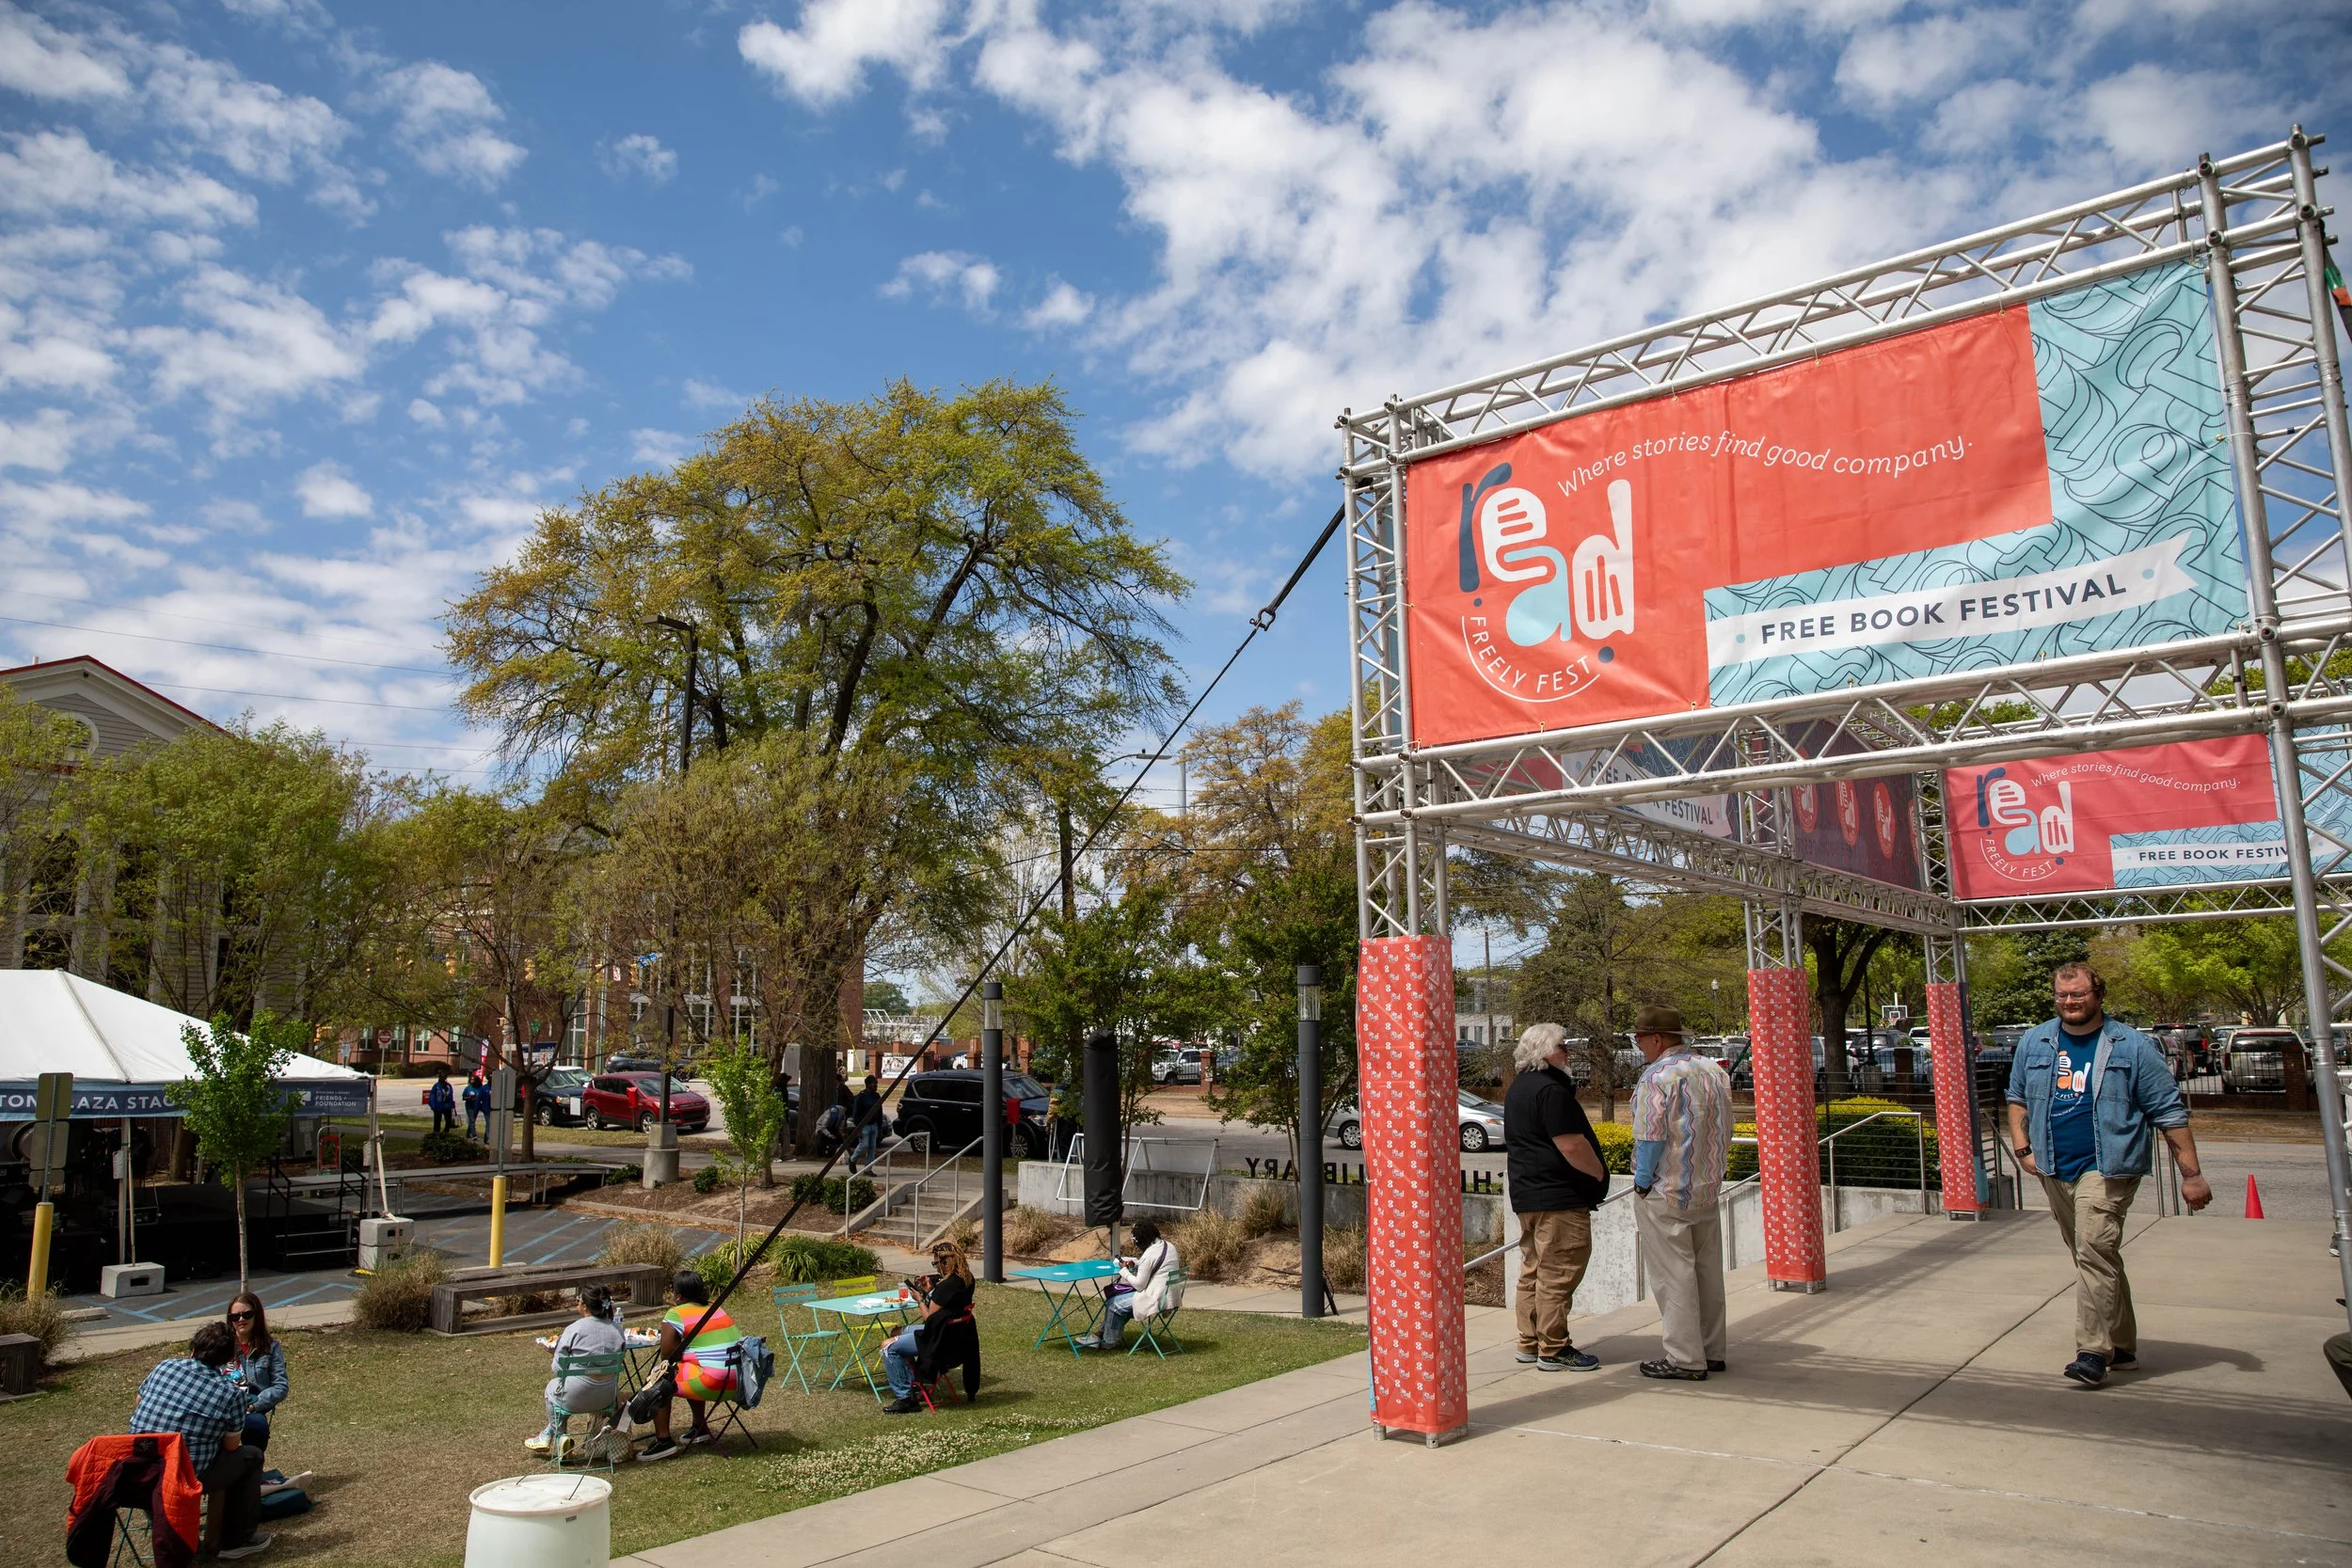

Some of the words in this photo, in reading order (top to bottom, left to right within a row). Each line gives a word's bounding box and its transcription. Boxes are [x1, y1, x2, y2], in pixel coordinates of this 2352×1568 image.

[1557, 451, 1627, 498] Where
[1632, 432, 1711, 460] stories
[1710, 430, 1766, 457] find
[1764, 445, 1831, 467] good
[1834, 436, 1973, 478] company.
[1458, 462, 1634, 646] read
[1761, 615, 1836, 644] FREE
[1851, 601, 1944, 632] BOOK
[1961, 573, 2126, 621] FESTIVAL
[1470, 616, 1527, 689] FREELY
[1536, 656, 1595, 693] FEST
[2030, 767, 2069, 787] Where
[2071, 762, 2112, 773] stories
[2112, 764, 2140, 778] find
[2139, 773, 2172, 787] good
[2173, 778, 2241, 793] company.
[1664, 799, 1713, 825] FESTIVAL
[1977, 767, 2074, 856] read
[1985, 838, 2017, 874] FREELY
[2022, 861, 2053, 878] FEST
[2139, 850, 2176, 862] FREE
[2183, 849, 2229, 860] BOOK
[2236, 847, 2288, 858] FESTIV
[2057, 1051, 2091, 1093] ead
[71, 1097, 119, 1109] AZA
[127, 1096, 180, 1109] STAG
